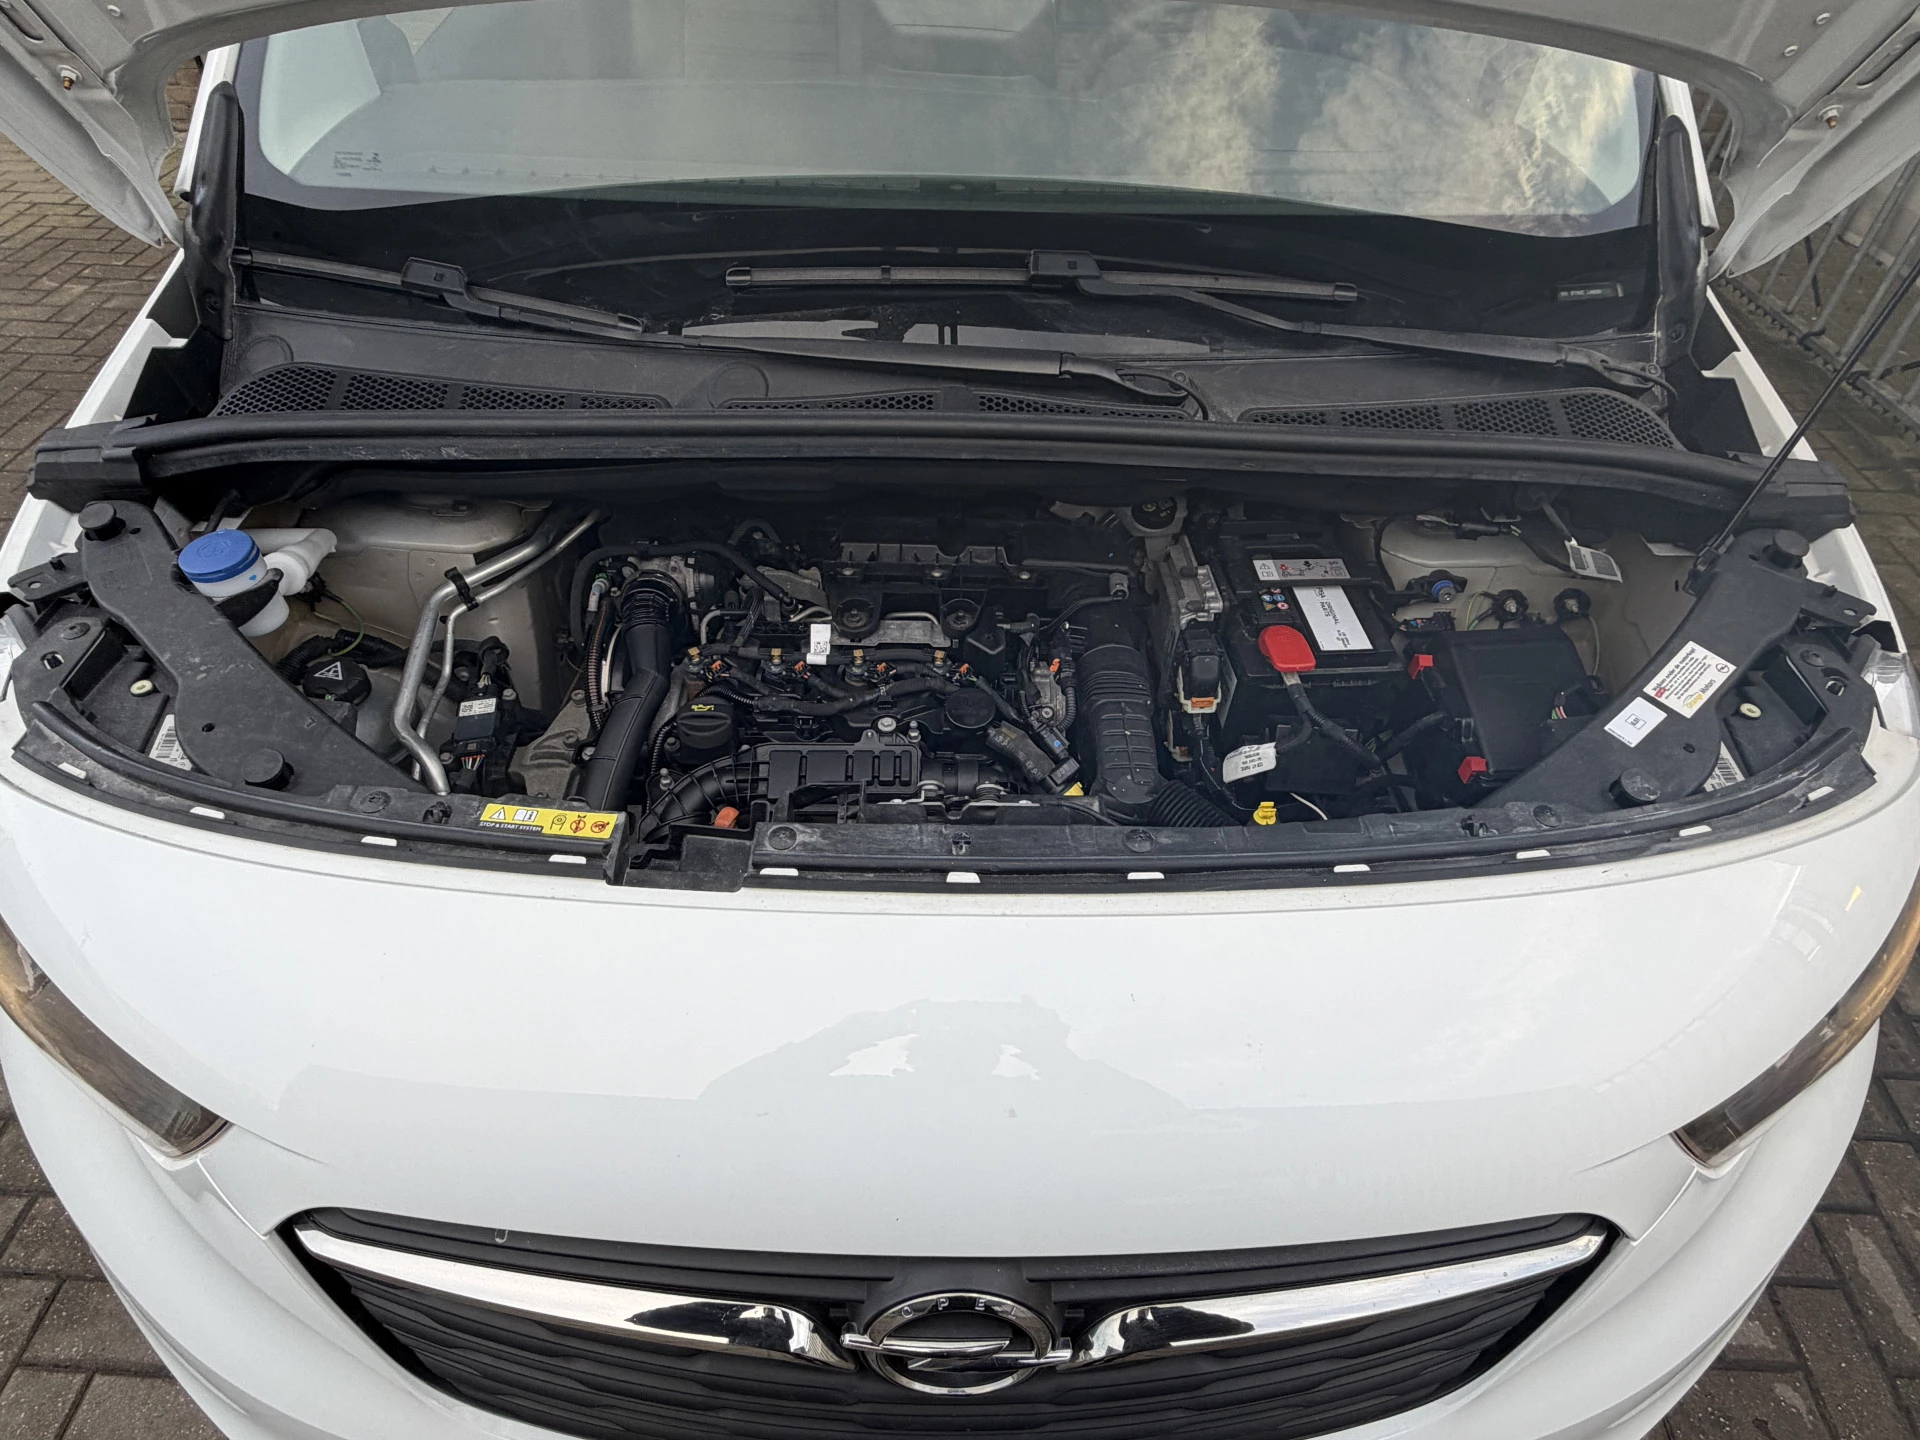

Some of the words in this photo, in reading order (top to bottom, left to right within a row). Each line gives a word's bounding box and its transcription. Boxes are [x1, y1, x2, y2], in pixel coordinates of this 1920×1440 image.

[1319, 601, 1331, 617] PARTS
[1325, 601, 1340, 624] ORIGINAL
[1699, 679, 1716, 694] Motors
[901, 1298, 1017, 1319] OPEL
